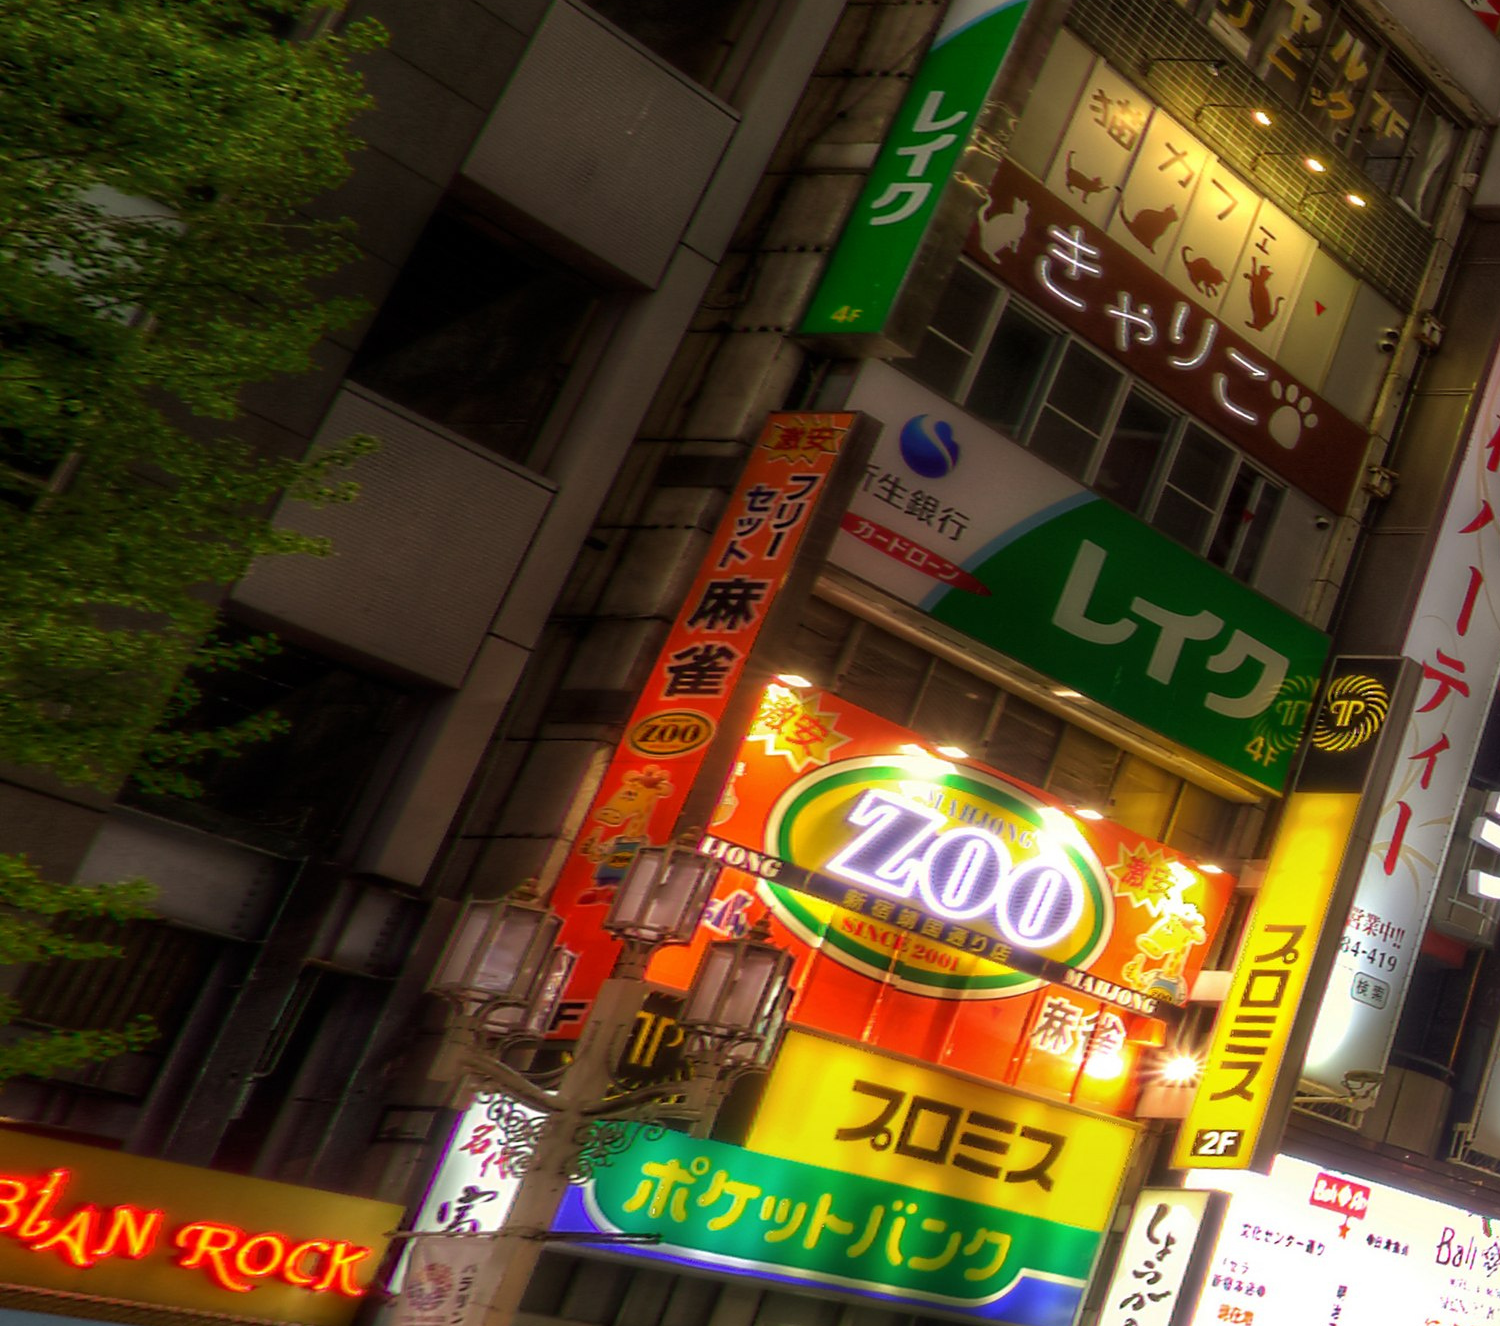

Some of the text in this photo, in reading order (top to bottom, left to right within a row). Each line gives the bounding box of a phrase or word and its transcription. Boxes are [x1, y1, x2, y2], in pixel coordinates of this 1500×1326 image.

[869, 89, 969, 227] レイク
[828, 303, 862, 325] 4F
[848, 518, 964, 586] カードローン
[662, 576, 769, 700] 麻雀
[1049, 537, 1293, 723] レイク
[1243, 734, 1281, 770] 4F
[826, 785, 1086, 951] ZOO
[840, 915, 909, 952] SINCE
[1063, 966, 1162, 1018] MAHJONG
[1208, 924, 1308, 1102] プロミス
[1355, 978, 1386, 1004] 検索
[835, 1078, 1070, 1192] プロミス
[1197, 1131, 1240, 1155] 2F
[622, 1156, 1014, 1281] ポケットバンク
[174, 1220, 374, 1297] ROCK
